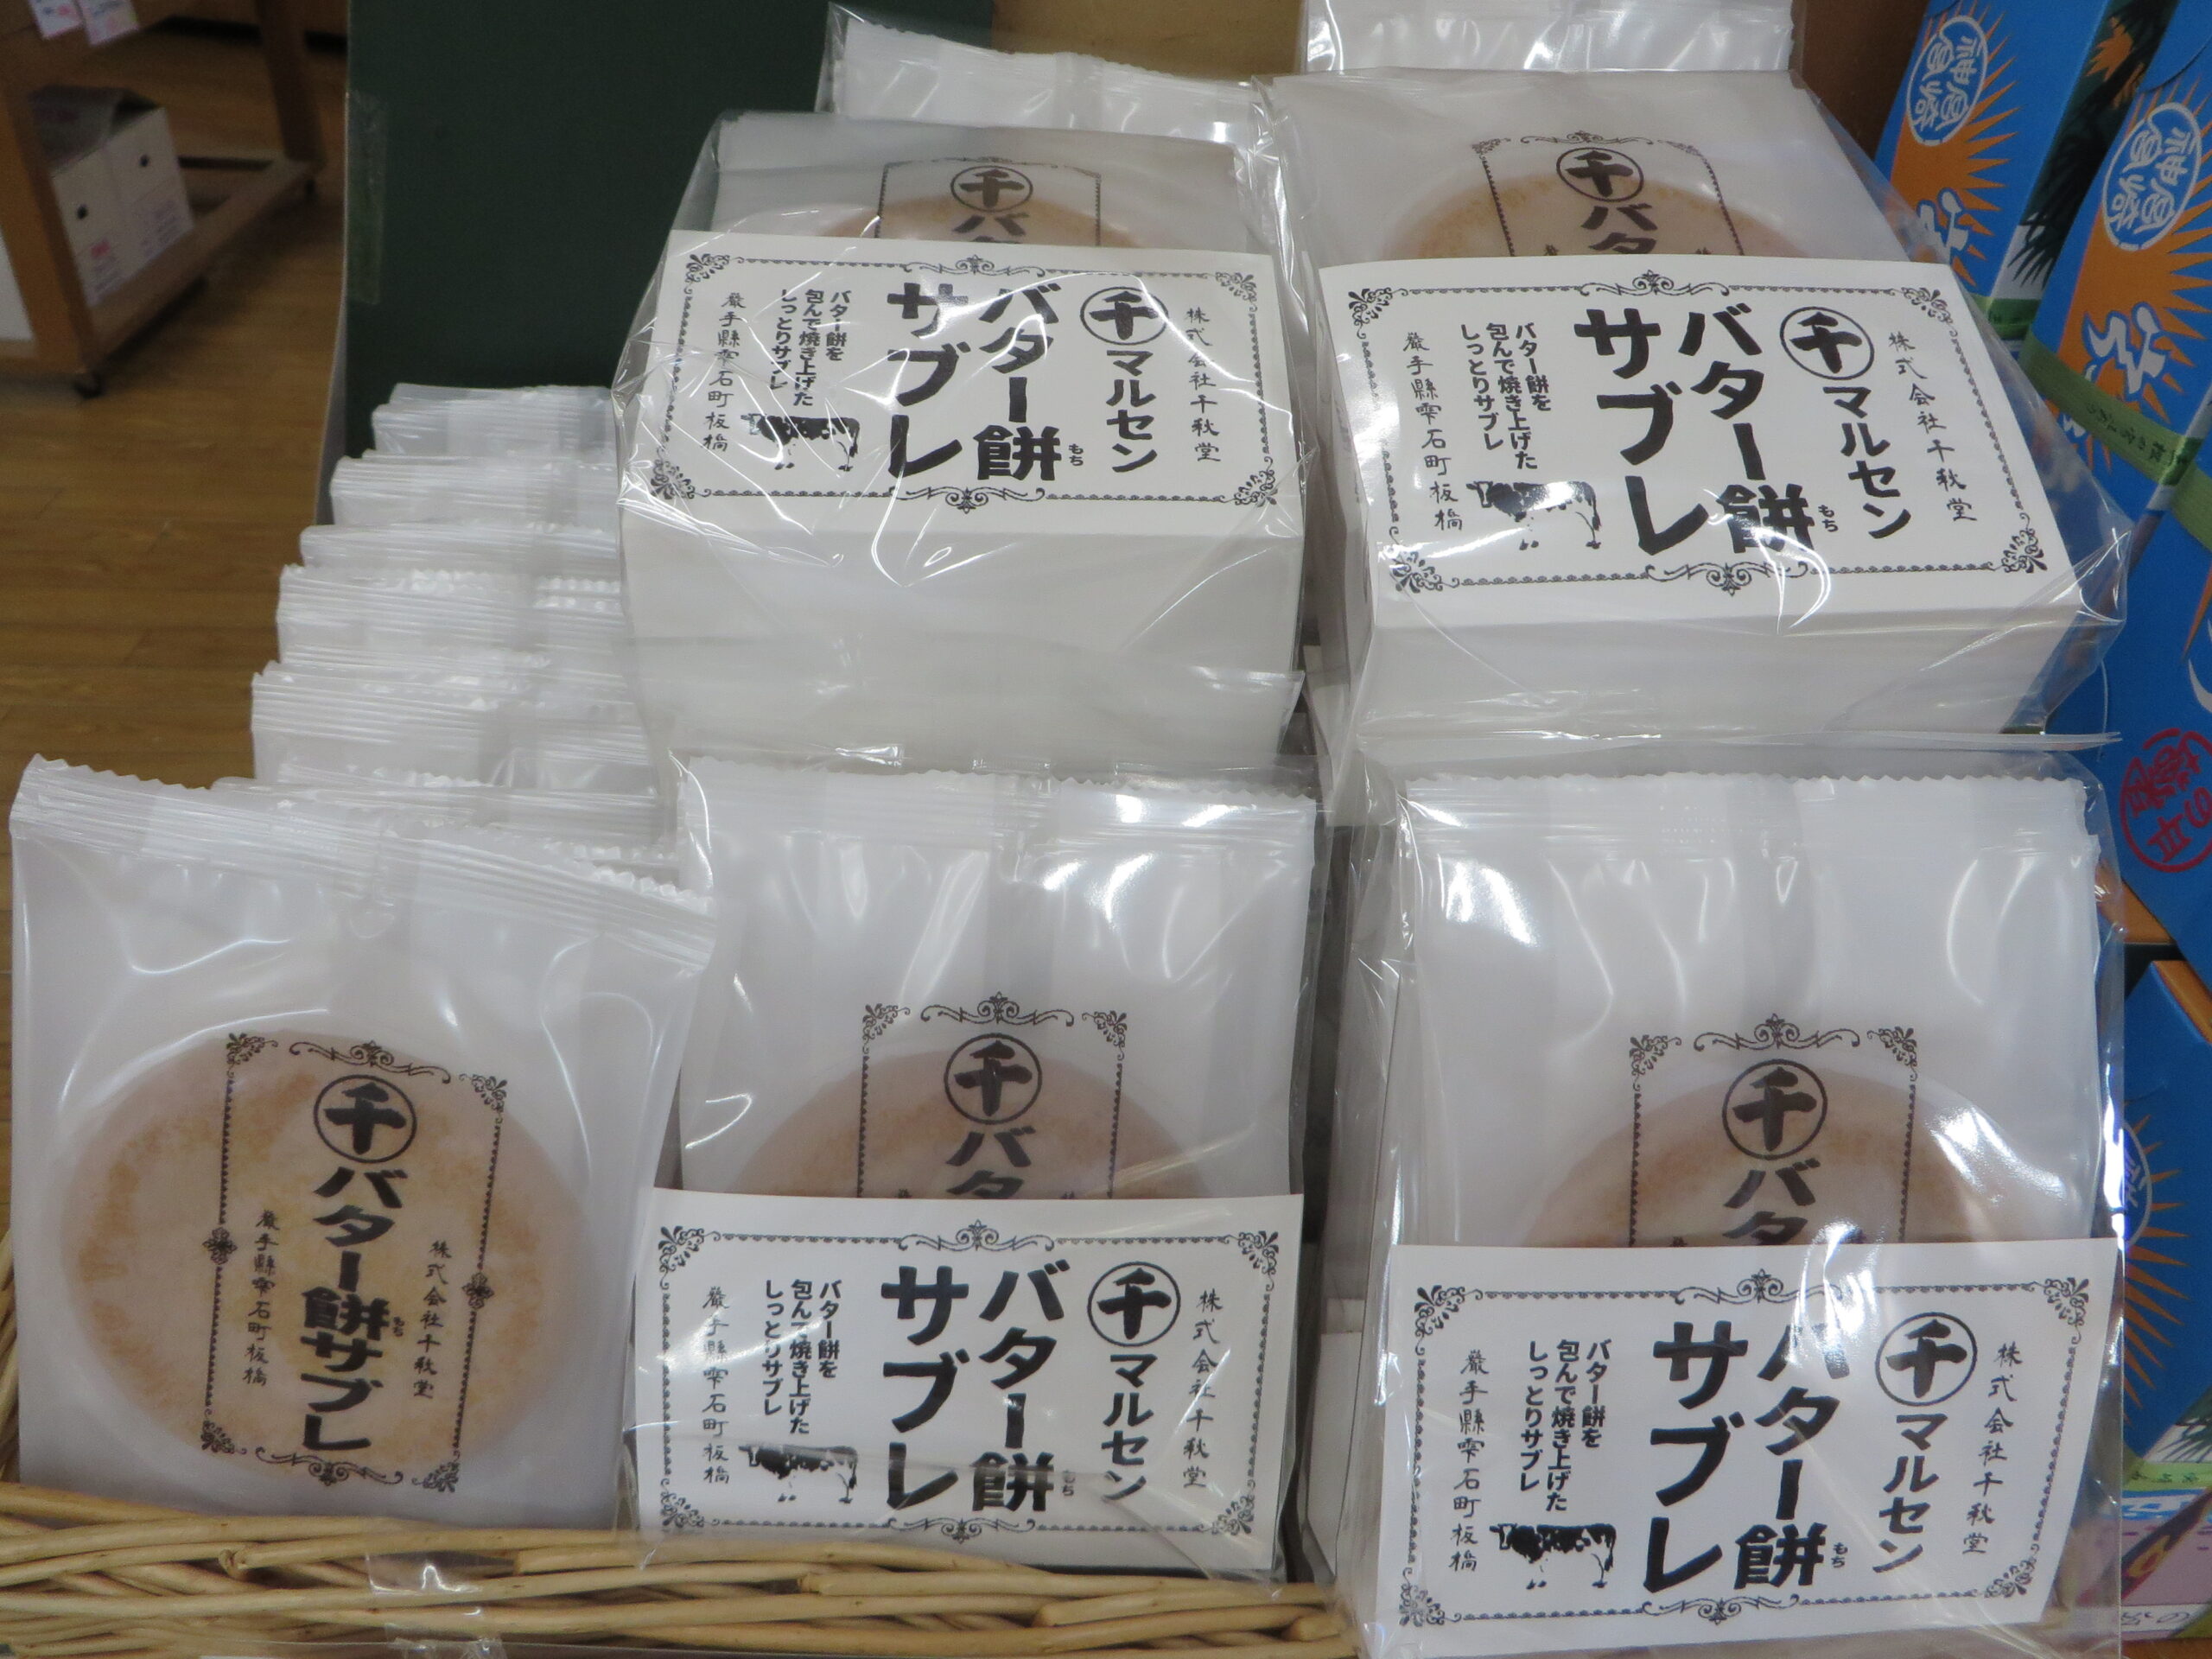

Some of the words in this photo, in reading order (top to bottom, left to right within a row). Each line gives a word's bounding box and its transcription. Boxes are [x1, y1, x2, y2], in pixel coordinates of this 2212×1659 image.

[952, 212, 1031, 244] バ
[770, 289, 798, 390] しっとりサブレ
[887, 283, 972, 479] サブレ
[973, 283, 1062, 480] バター餅
[1106, 350, 1158, 472] マルセン
[1461, 324, 1503, 450] しっとりサブレ
[1486, 322, 1537, 469] 包んで焼き上げた
[1516, 322, 1551, 411] バター餅を
[1573, 308, 1709, 556] サブレ
[1678, 303, 1815, 554] バター餅
[1822, 386, 1912, 539] マルセン
[817, 1280, 842, 1378] バター餅を
[880, 1265, 969, 1509] サブレ
[969, 1259, 1070, 1511] バター餅
[1582, 1339, 1611, 1448] バター餅を
[1102, 1354, 1158, 1500] マルセン
[1521, 1341, 1548, 1491] しっとりサブレ
[1546, 1340, 1580, 1511] 包んで焼き上げた
[1643, 1320, 1748, 1593] サブレ
[1872, 1414, 1948, 1573] マルセン
